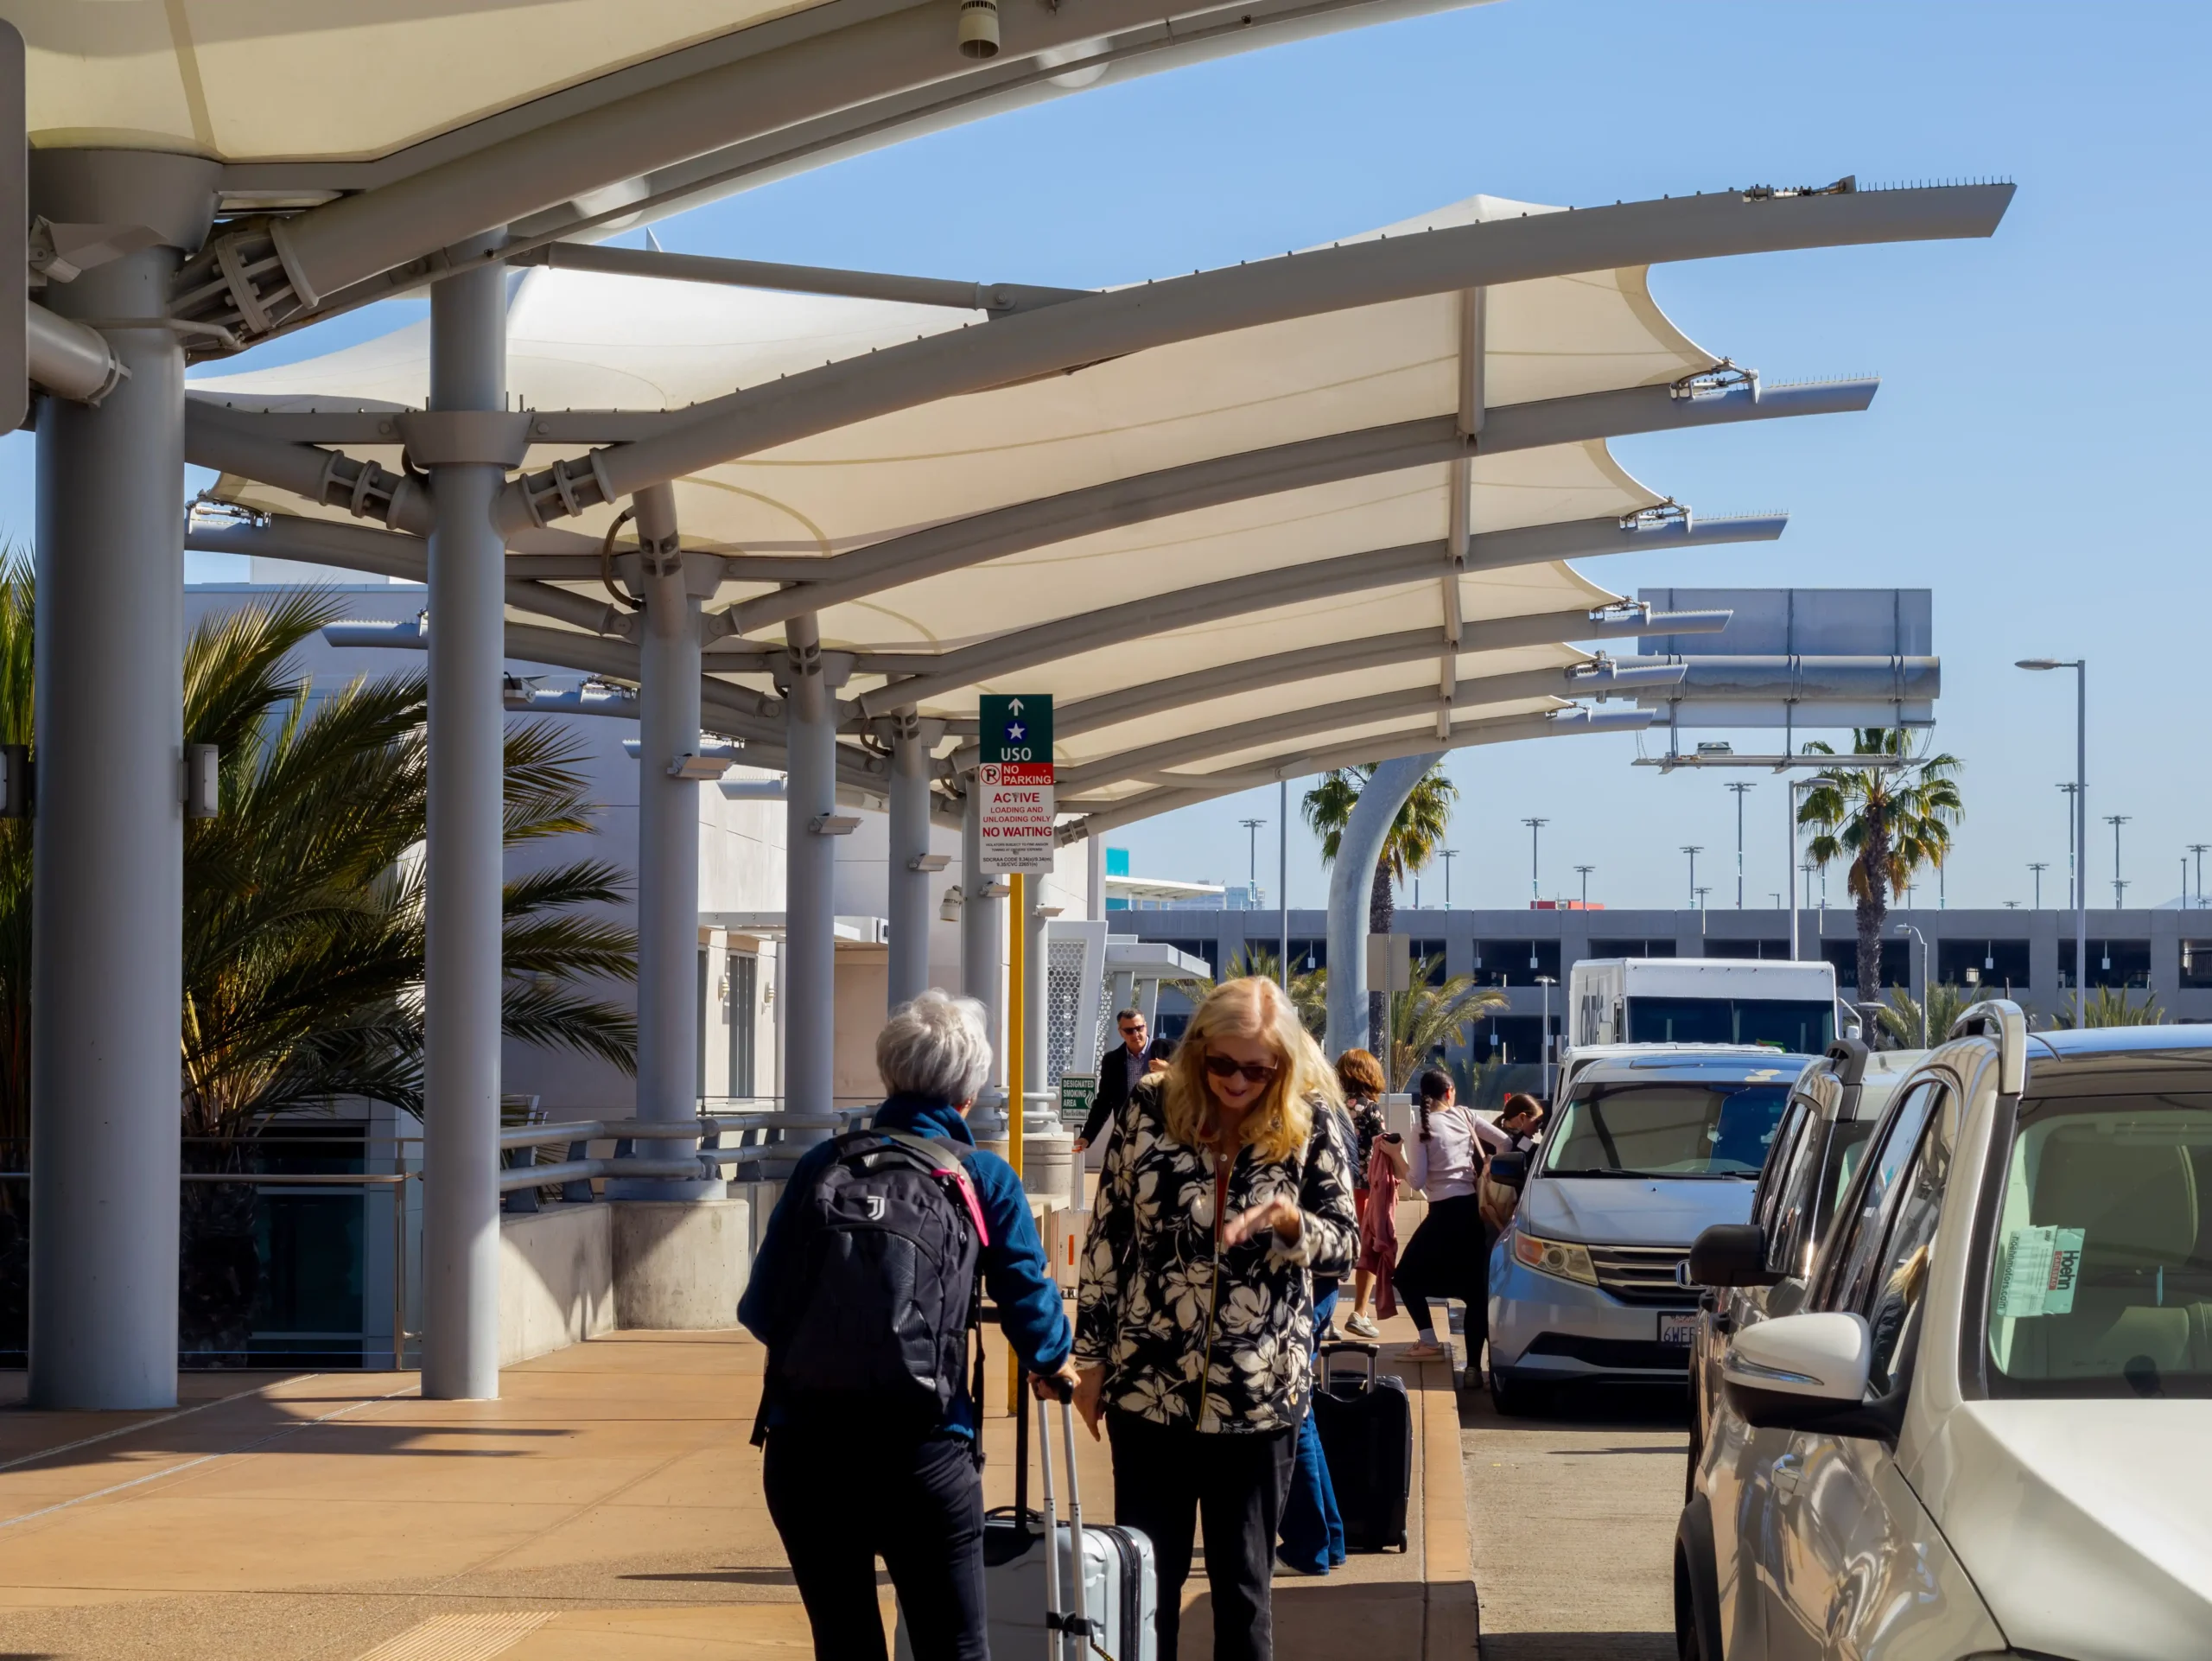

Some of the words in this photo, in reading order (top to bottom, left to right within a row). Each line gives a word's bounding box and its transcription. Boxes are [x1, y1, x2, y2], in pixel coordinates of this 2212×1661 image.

[1001, 748, 1032, 761] USO
[1003, 765, 1019, 775] NO
[1003, 775, 1052, 785] PARKING
[993, 792, 1040, 804] ACTIVE
[982, 827, 1000, 837] NO
[1003, 826, 1052, 837] WAITING
[1063, 1079, 1094, 1088] DESIGNATED
[1063, 1089, 1086, 1098] SMOKING
[2056, 1250, 2080, 1290] Hoehn
